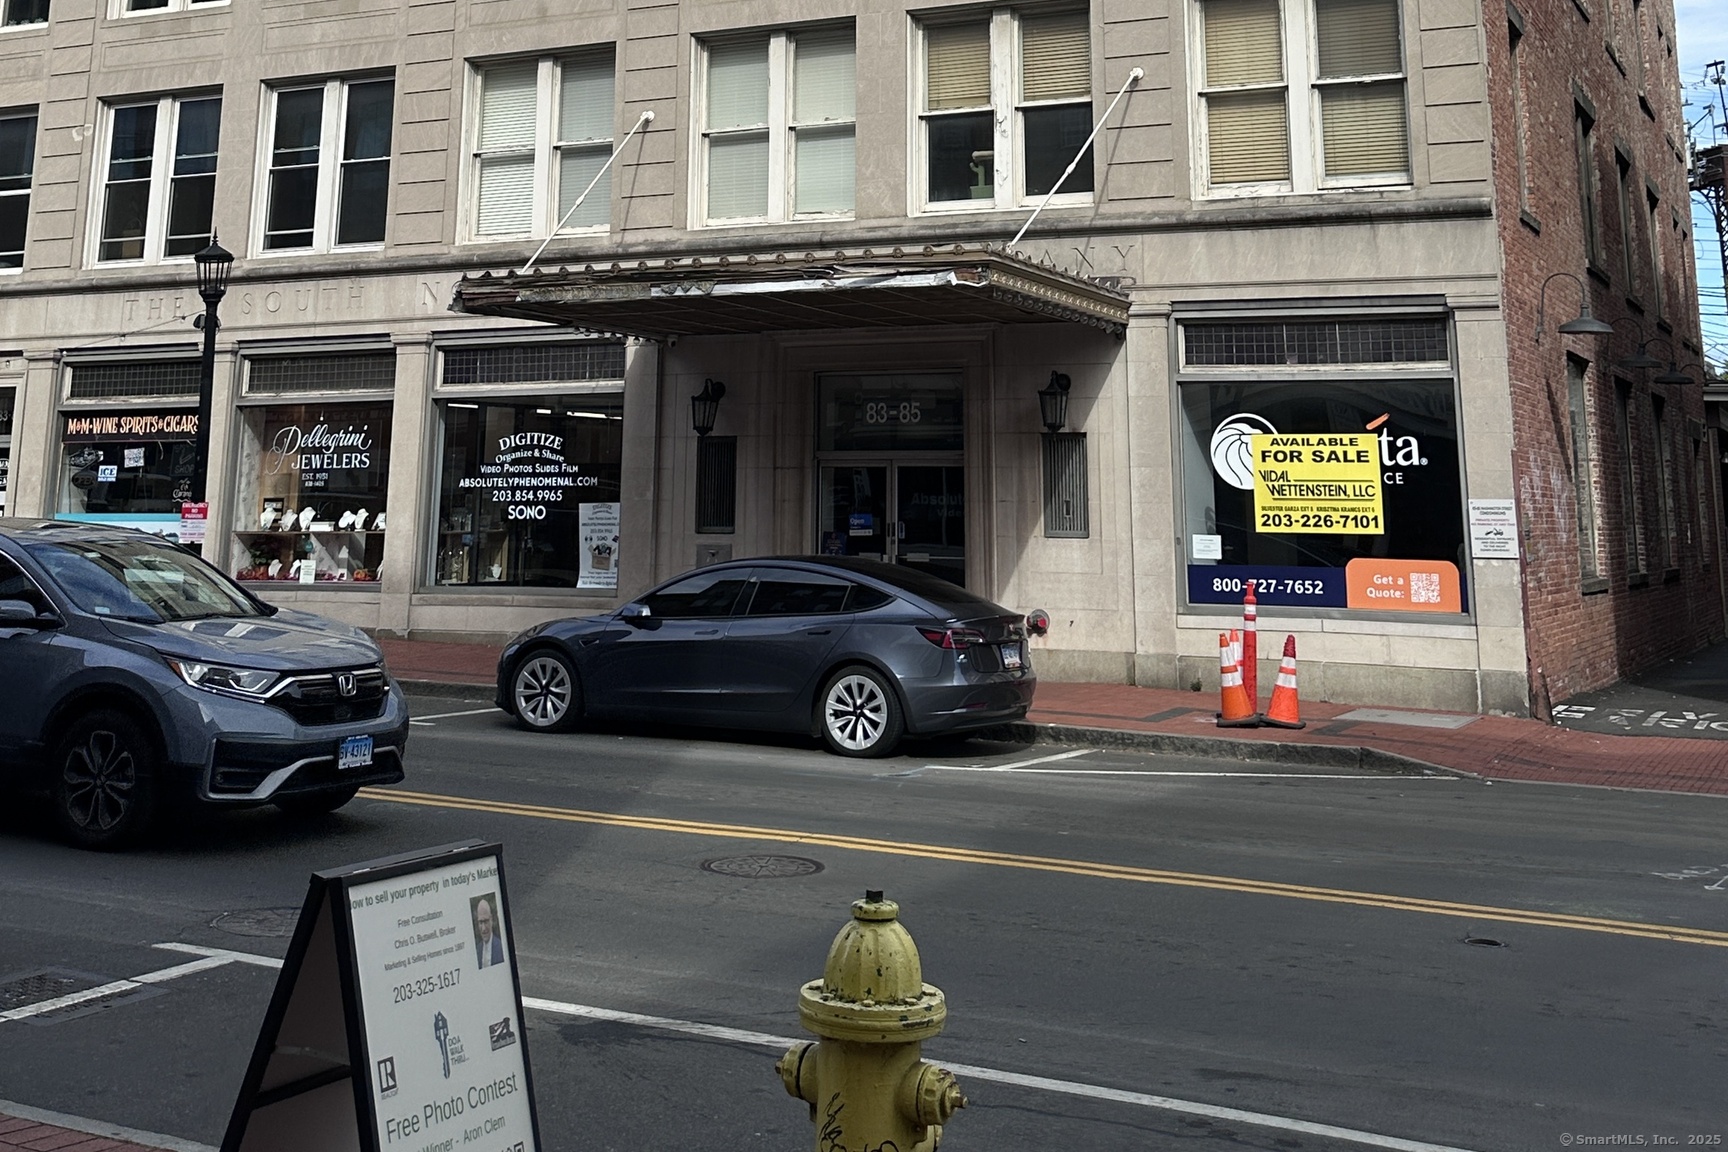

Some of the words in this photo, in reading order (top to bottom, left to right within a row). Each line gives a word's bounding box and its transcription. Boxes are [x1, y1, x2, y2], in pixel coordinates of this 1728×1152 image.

[125, 297, 184, 322] THE
[241, 284, 364, 315] SOUTH
[866, 402, 921, 423] 83-85
[499, 432, 563, 450] DIGITIZE
[1270, 437, 1359, 447] AVAILABLE
[265, 424, 372, 476] Pellegrini
[495, 449, 532, 464] Organize
[533, 449, 540, 458] &
[541, 450, 565, 463] Share
[1261, 450, 1303, 463] FOR
[1312, 450, 1370, 463] SALE
[291, 453, 370, 470] JEWELERS
[459, 477, 598, 488] ABSOLUTELYPHENOMENAL.COM
[1258, 470, 1291, 482] VIDAL
[1384, 473, 1404, 484] CE
[492, 490, 563, 502] 203.854.9965
[1265, 484, 1350, 498] WETTENSTEIN,
[1353, 485, 1376, 497] LLC
[911, 492, 964, 506] Absolut
[508, 505, 546, 520] SONO
[937, 508, 964, 517] Vide
[1261, 514, 1379, 528] 203-226-7101
[1373, 575, 1393, 586] Get
[1366, 587, 1405, 599] Quote:
[351, 898, 364, 910] ow
[365, 896, 374, 906] to
[375, 890, 388, 905] sell
[390, 888, 407, 903] your
[409, 881, 439, 898] property
[443, 879, 450, 888] in
[451, 872, 476, 886] today's
[477, 867, 498, 879] Marke
[397, 918, 411, 928] Free
[411, 910, 443, 925] Consultation
[393, 968, 460, 1004] 203-325-1617
[450, 1044, 464, 1056] WALK
[386, 1113, 420, 1144] Free
[424, 1096, 464, 1128] Photo
[467, 1072, 518, 1109] Contest
[463, 1126, 482, 1145] Aron
[484, 1116, 506, 1135] Clem
